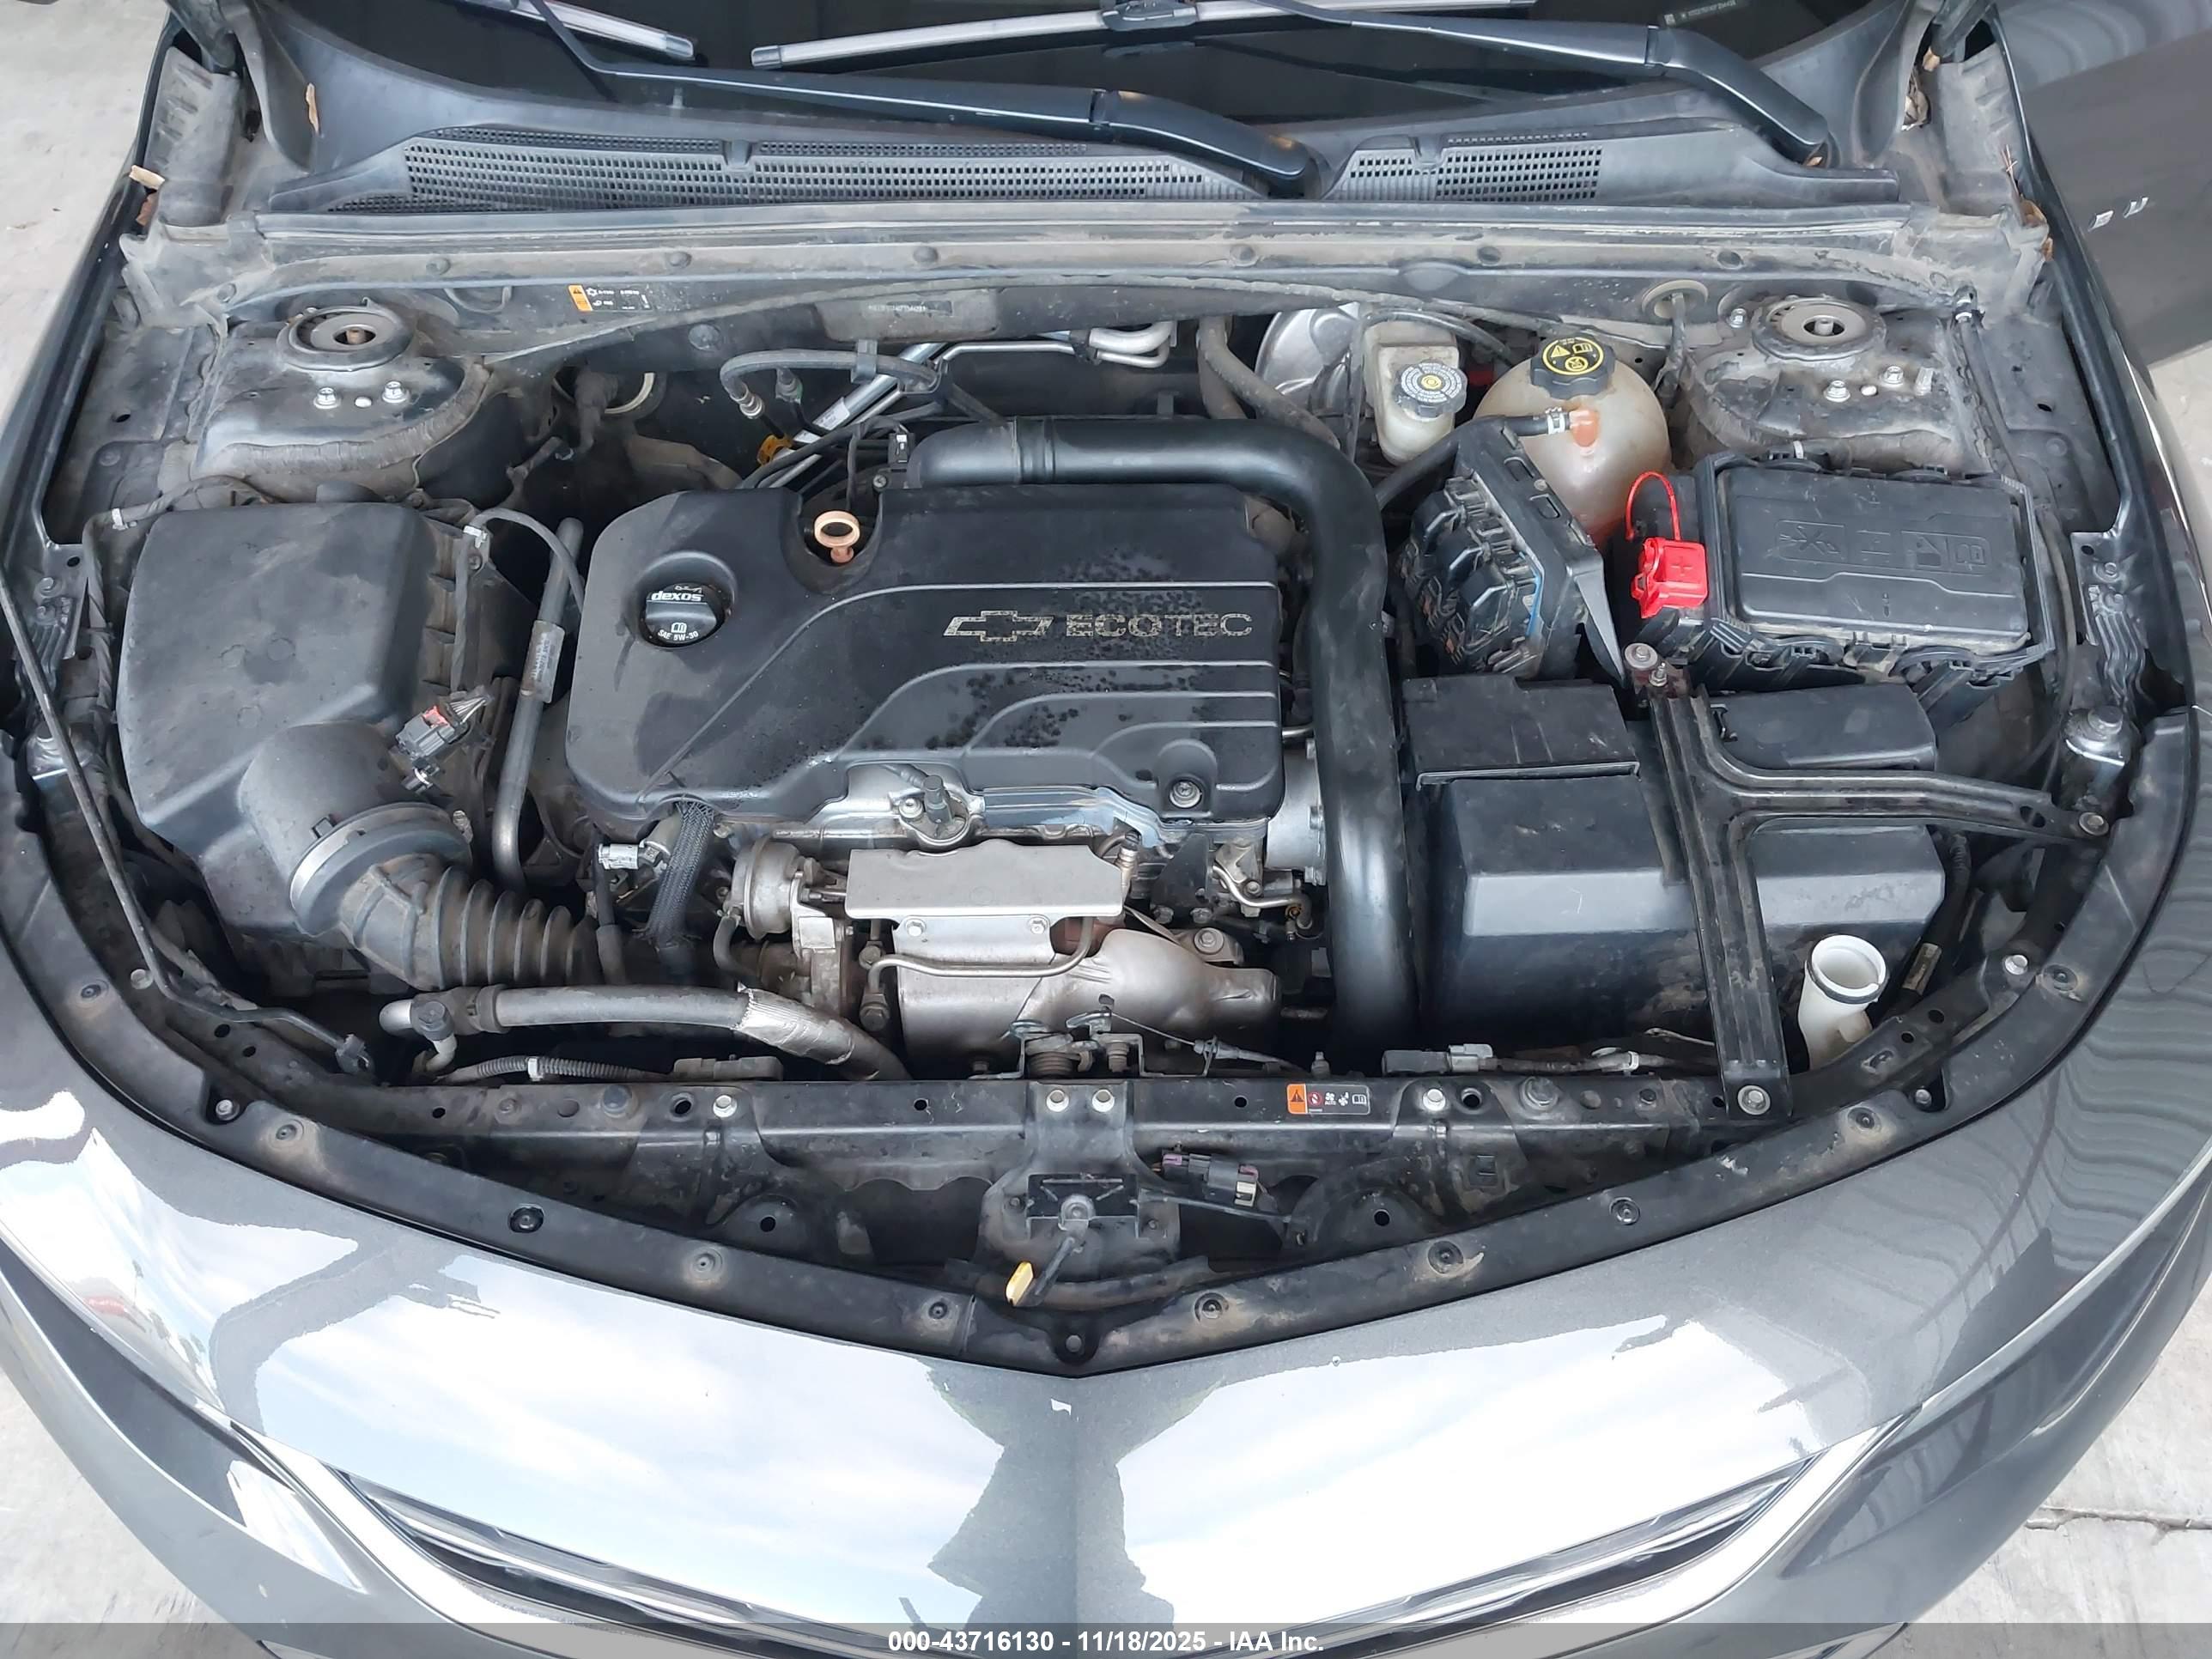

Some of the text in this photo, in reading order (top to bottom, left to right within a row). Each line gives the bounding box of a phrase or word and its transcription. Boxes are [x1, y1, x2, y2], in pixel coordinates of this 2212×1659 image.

[651, 590, 704, 602] dexos
[1066, 613, 1253, 637] ECOTEC
[658, 629, 699, 641] SAE 5W-30
